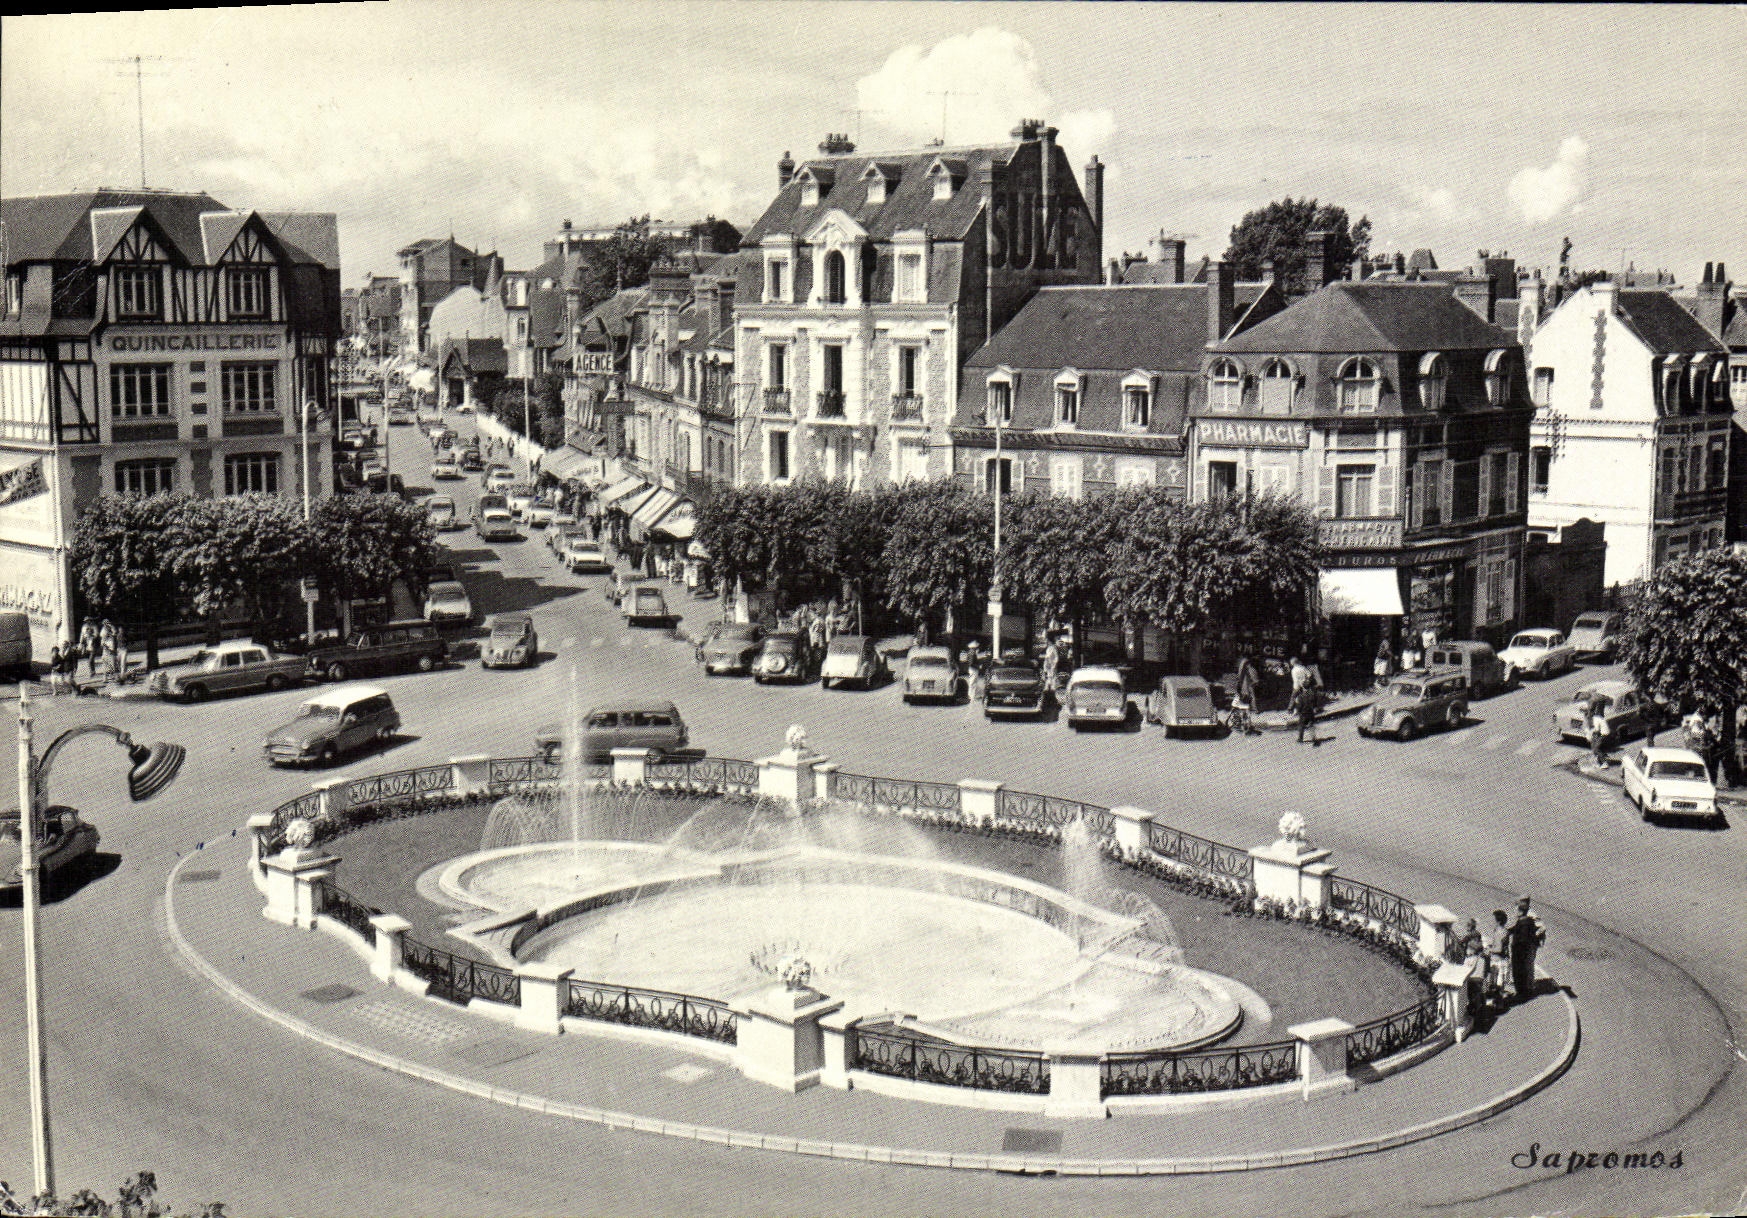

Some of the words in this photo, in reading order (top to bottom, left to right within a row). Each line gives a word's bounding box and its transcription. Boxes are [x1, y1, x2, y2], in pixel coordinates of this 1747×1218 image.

[112, 334, 277, 351] QUINCAILLERIE
[577, 354, 612, 371] AGENCE
[1199, 422, 1306, 443] PHARMACIE
